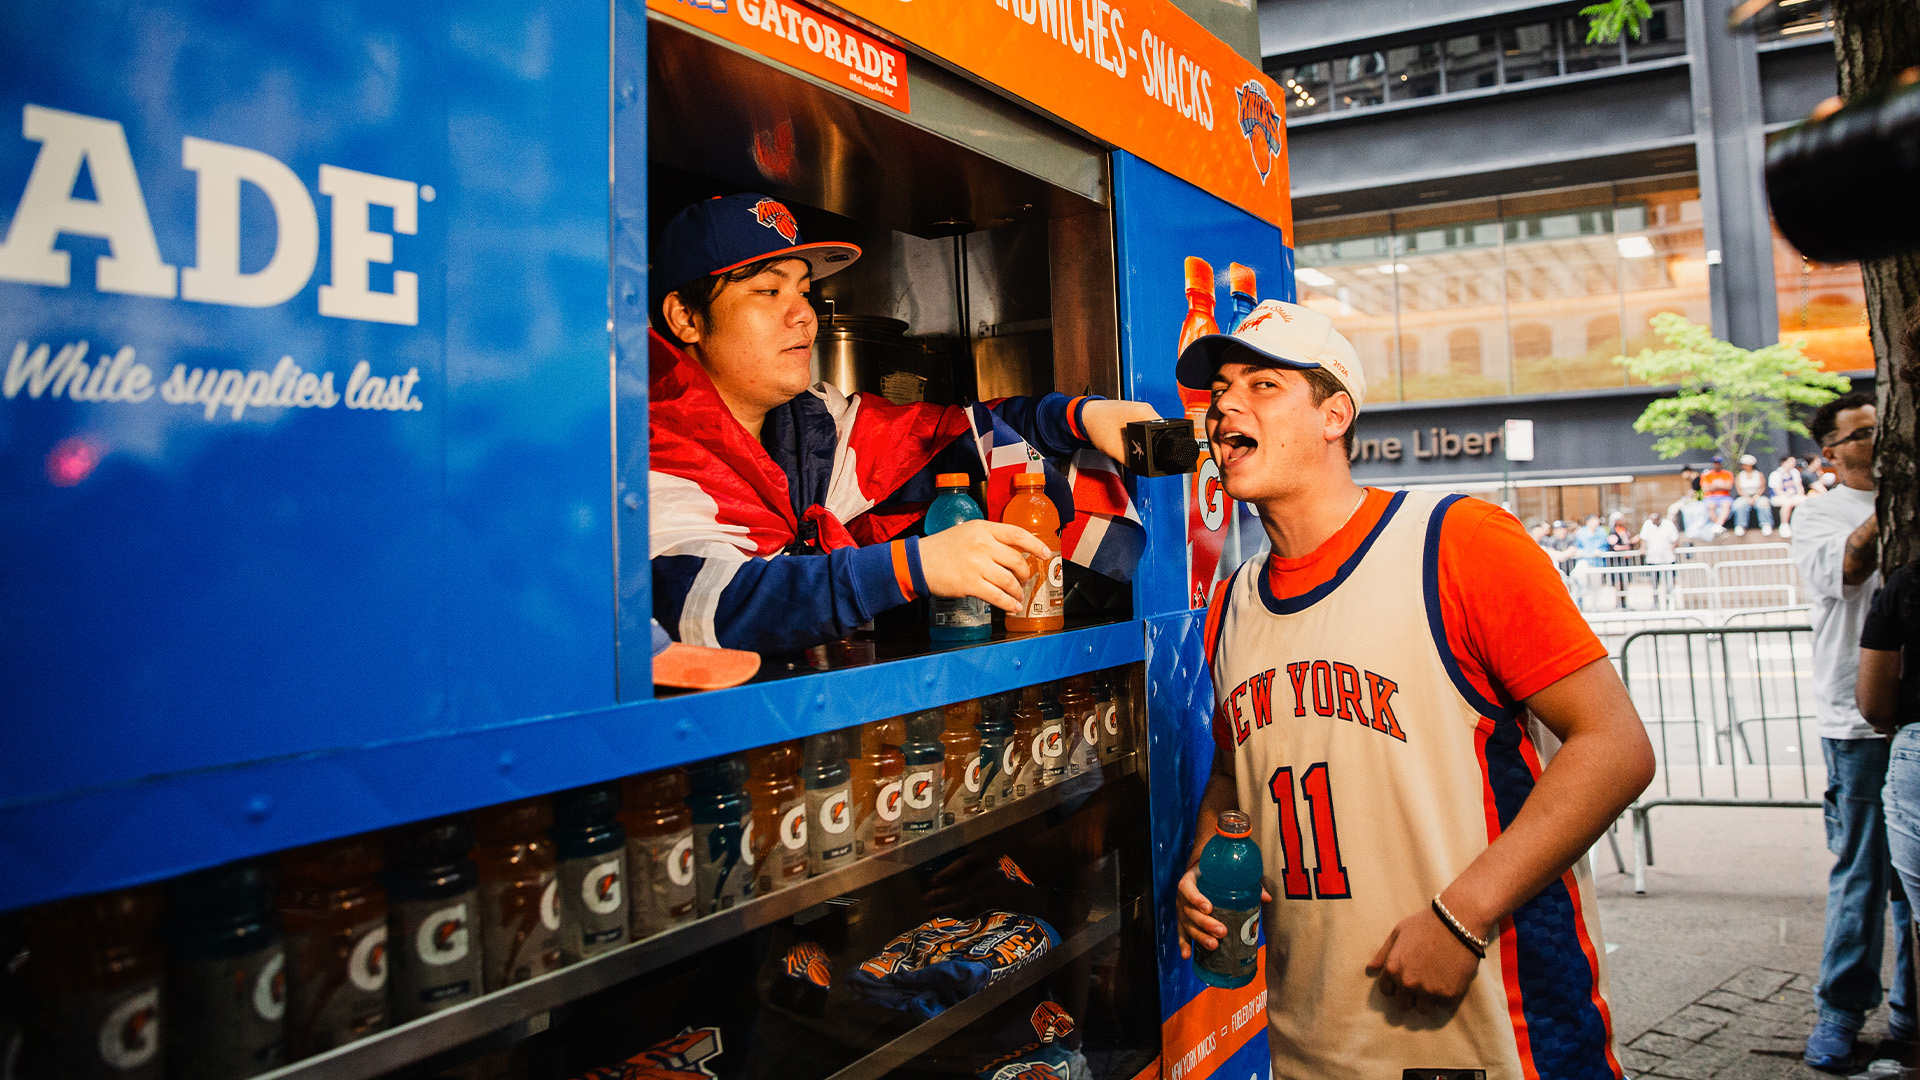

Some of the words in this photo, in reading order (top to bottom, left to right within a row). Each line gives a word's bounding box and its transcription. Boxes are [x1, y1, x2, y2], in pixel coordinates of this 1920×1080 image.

[737, 0, 898, 87] GATORADE
[1141, 28, 1214, 131] SNACKS
[0, 104, 418, 326] ADE
[3, 340, 155, 402] While
[163, 355, 341, 421] supplies
[344, 360, 424, 412] last.
[1197, 457, 1225, 532] G
[1287, 660, 1407, 743] YORK
[1043, 723, 1063, 758] G
[820, 789, 850, 834] G
[905, 771, 934, 809] G
[1268, 761, 1352, 900] 11
[582, 858, 622, 914] G
[416, 904, 468, 965] G
[1182, 1046, 1198, 1075] YORK
